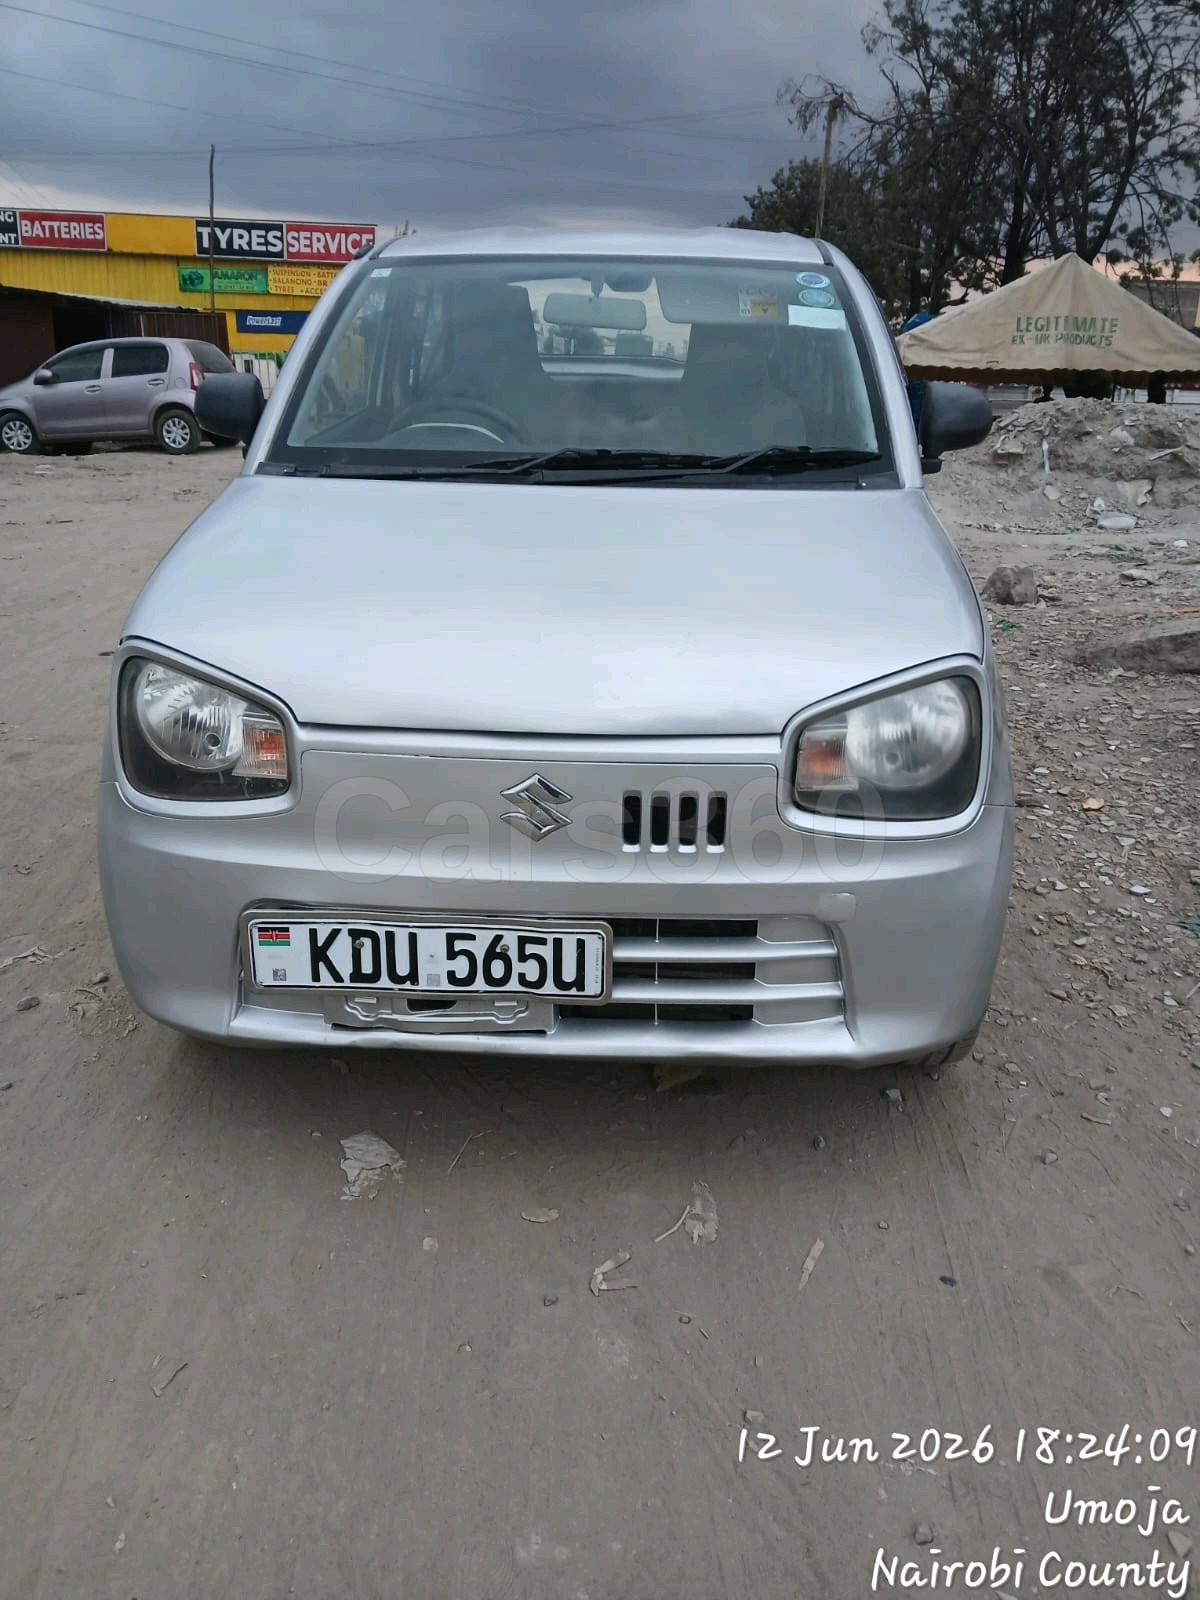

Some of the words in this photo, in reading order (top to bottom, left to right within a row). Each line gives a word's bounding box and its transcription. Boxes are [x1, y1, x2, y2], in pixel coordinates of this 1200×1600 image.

[21, 220, 104, 240] BATTERIES
[197, 226, 284, 253] TYRES
[272, 269, 311, 277] SUSPENSION
[272, 277, 312, 286] BALANCING
[274, 286, 294, 294] TYRES
[1016, 315, 1120, 334] LEGITIMATE
[1055, 333, 1114, 346] PRODUCTS
[308, 926, 420, 986] KDU
[445, 931, 586, 993] 565U
